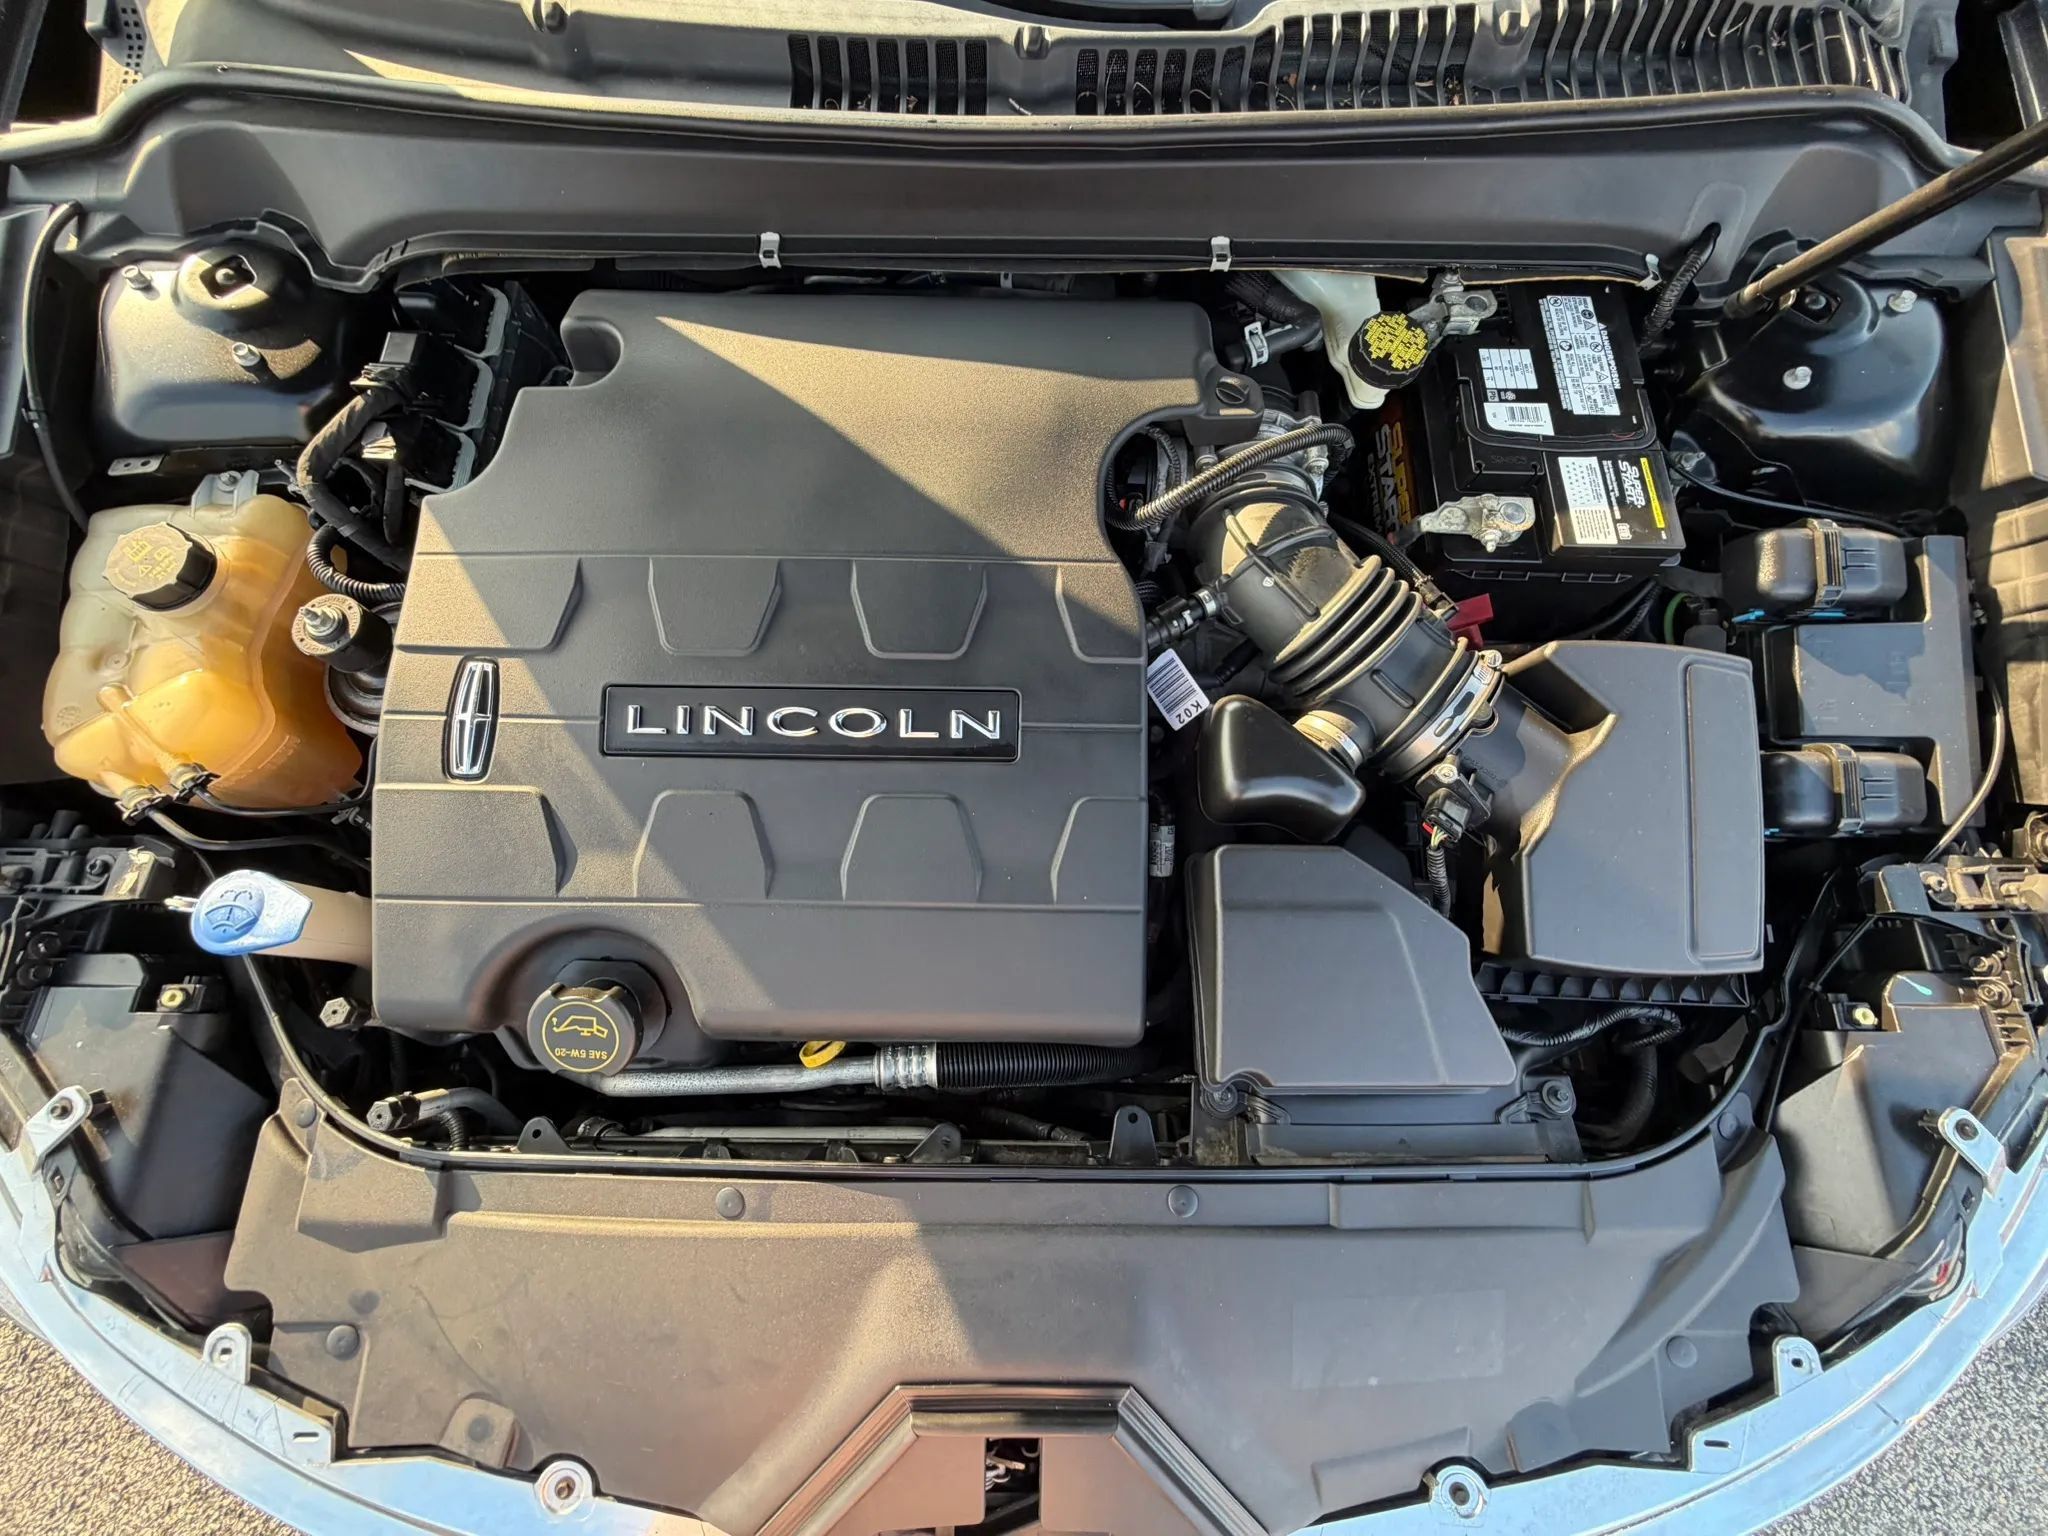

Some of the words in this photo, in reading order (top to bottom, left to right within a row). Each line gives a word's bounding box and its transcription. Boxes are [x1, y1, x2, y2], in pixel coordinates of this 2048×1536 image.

[1489, 391, 1497, 401] Pb
[1367, 453, 1383, 535] EXTREM
[1618, 459, 1637, 505] START
[1630, 465, 1646, 506] SUPER
[626, 704, 1001, 739] LINCOLN
[1176, 700, 1203, 724] K02
[554, 1047, 587, 1058] 5W-20
[588, 1049, 608, 1060] SAE
